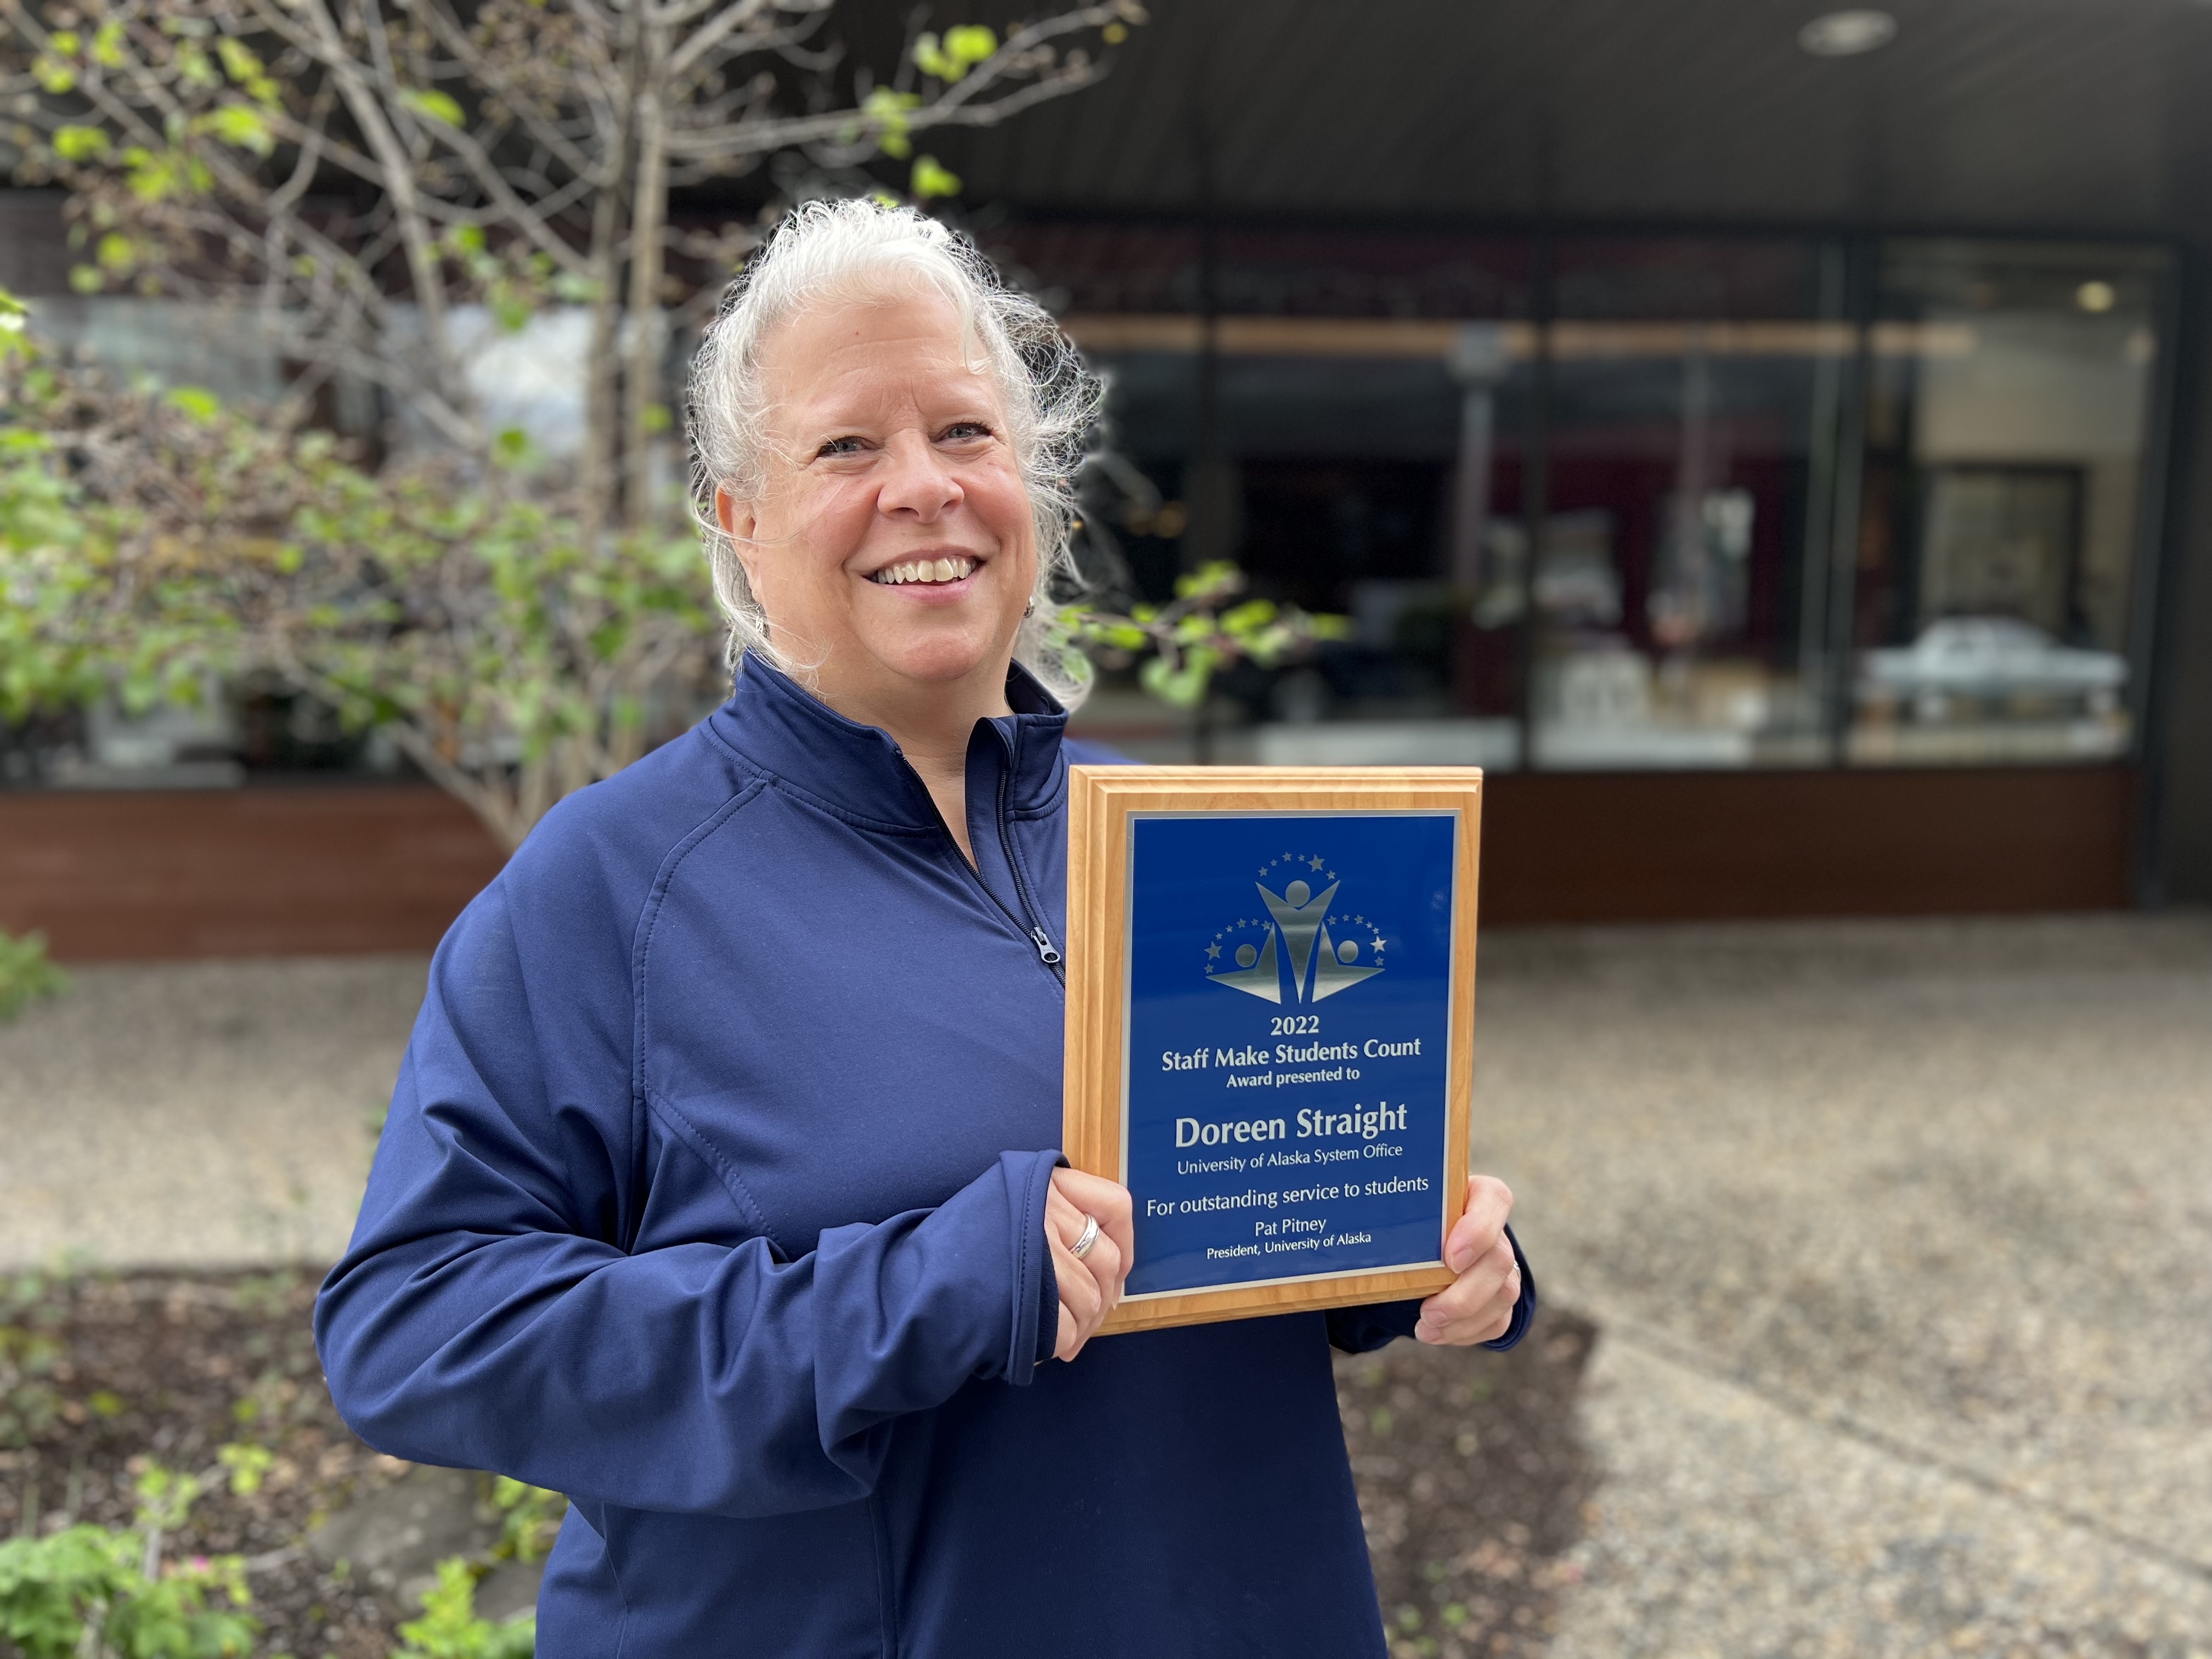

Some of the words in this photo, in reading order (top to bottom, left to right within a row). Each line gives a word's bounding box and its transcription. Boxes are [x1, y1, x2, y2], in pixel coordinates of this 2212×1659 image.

[1270, 1015, 1319, 1036] 2022
[1162, 1047, 1209, 1071] Staff
[1215, 1045, 1269, 1068] Make
[1275, 1041, 1358, 1064] Students
[1363, 1037, 1421, 1058] Count
[1226, 1070, 1272, 1088] Award
[1276, 1066, 1342, 1088] presented
[1345, 1067, 1361, 1080] to
[1175, 1117, 1285, 1148] Doreen
[1296, 1101, 1408, 1139] Straight
[1177, 1156, 1246, 1175] University
[1250, 1152, 1265, 1169] of
[1267, 1150, 1311, 1167] Alaska
[1314, 1149, 1359, 1165] System
[1363, 1143, 1403, 1158] Office
[1147, 1199, 1176, 1217] For
[1180, 1189, 1278, 1214] outstanding
[1282, 1183, 1340, 1204] service
[1344, 1183, 1360, 1198] to
[1364, 1176, 1429, 1196] students
[1255, 1221, 1278, 1237] Pat
[1282, 1217, 1327, 1234] Pitney
[1207, 1244, 1261, 1260] President,
[1265, 1237, 1320, 1254] University
[1323, 1234, 1335, 1248] of
[1336, 1231, 1372, 1246] Alaska
